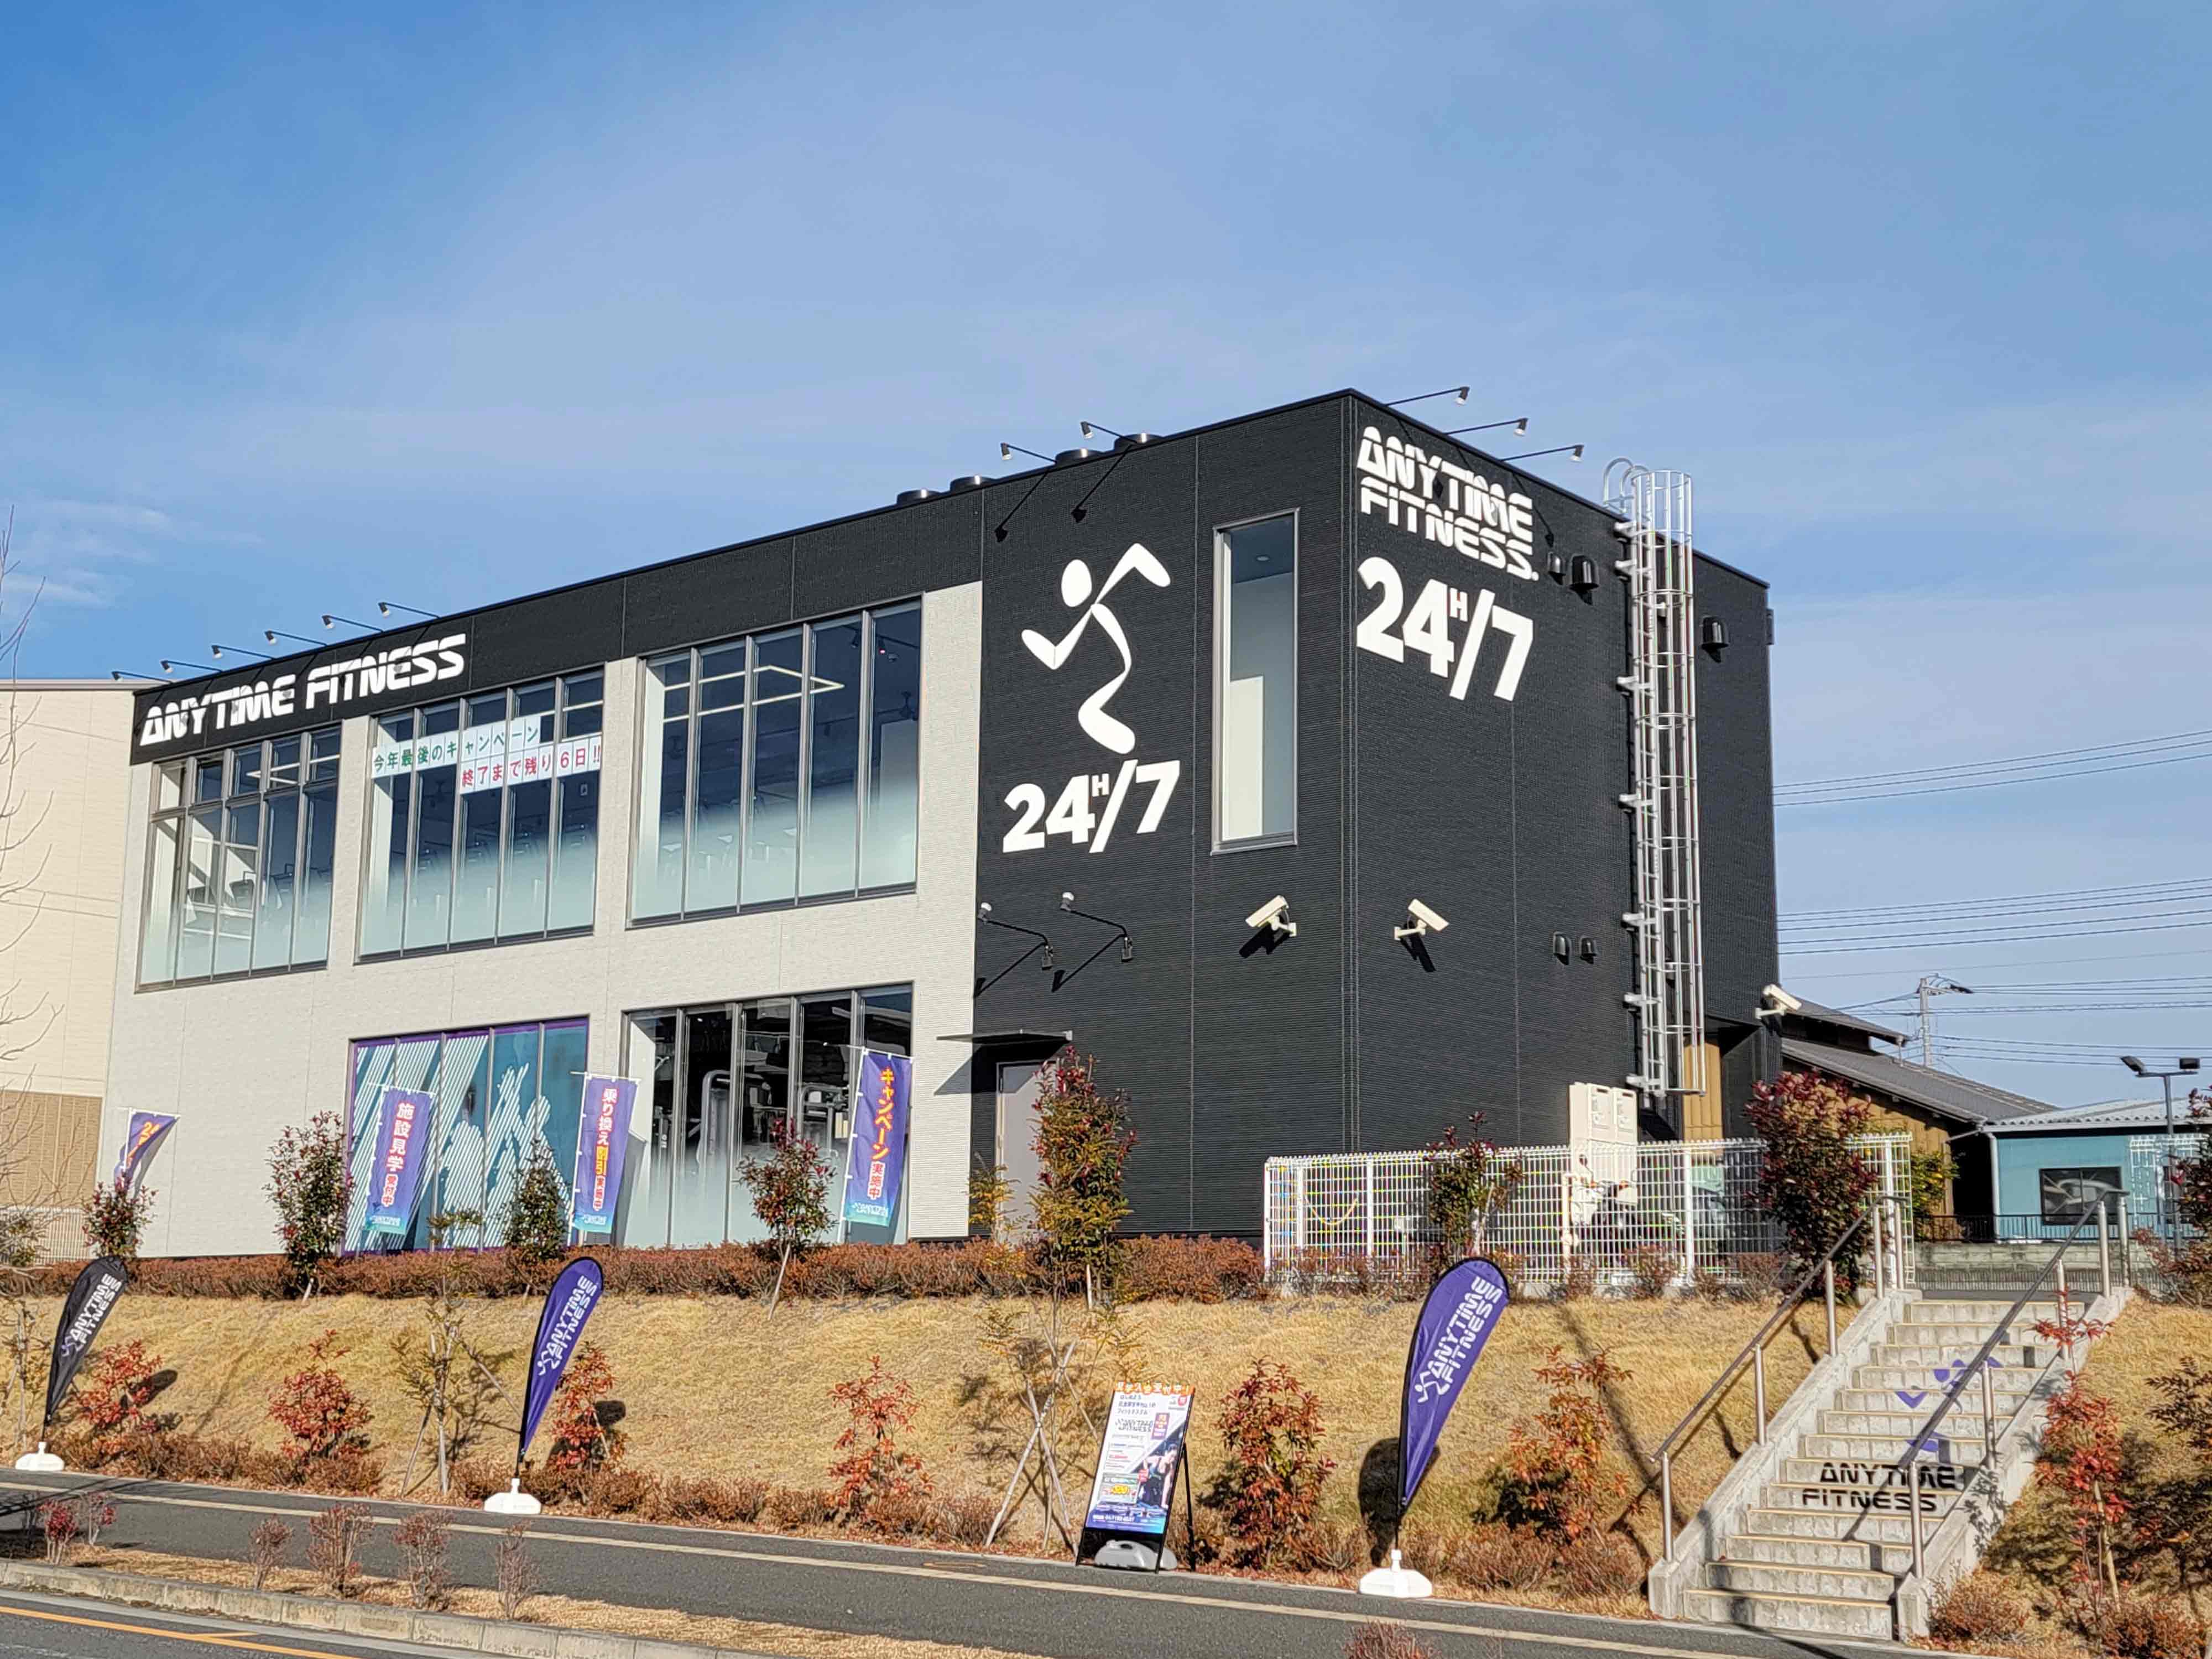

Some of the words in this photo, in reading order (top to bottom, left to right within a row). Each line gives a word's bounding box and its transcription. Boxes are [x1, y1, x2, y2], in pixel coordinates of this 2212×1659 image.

[1357, 426, 1533, 542] ANYTIME
[1361, 476, 1533, 580] FITNESS
[1357, 556, 1533, 702] 24H/7
[140, 674, 296, 746] ANYTIME
[306, 633, 466, 709] FITNESS
[373, 726, 539, 771] 今年最後のキャンペーン
[1003, 759, 1181, 853] 24H/7
[70, 1273, 115, 1342] ANYTIME
[79, 1281, 122, 1344] FITNESS
[546, 1275, 590, 1356] ANYTIME
[555, 1282, 597, 1361] FITNESS
[1428, 1276, 1489, 1379] ANYTIME
[1441, 1284, 1503, 1383] FITNESS
[1802, 1488, 1937, 1511] FITNESS
[1820, 1462, 1955, 1488] ANYTIME
